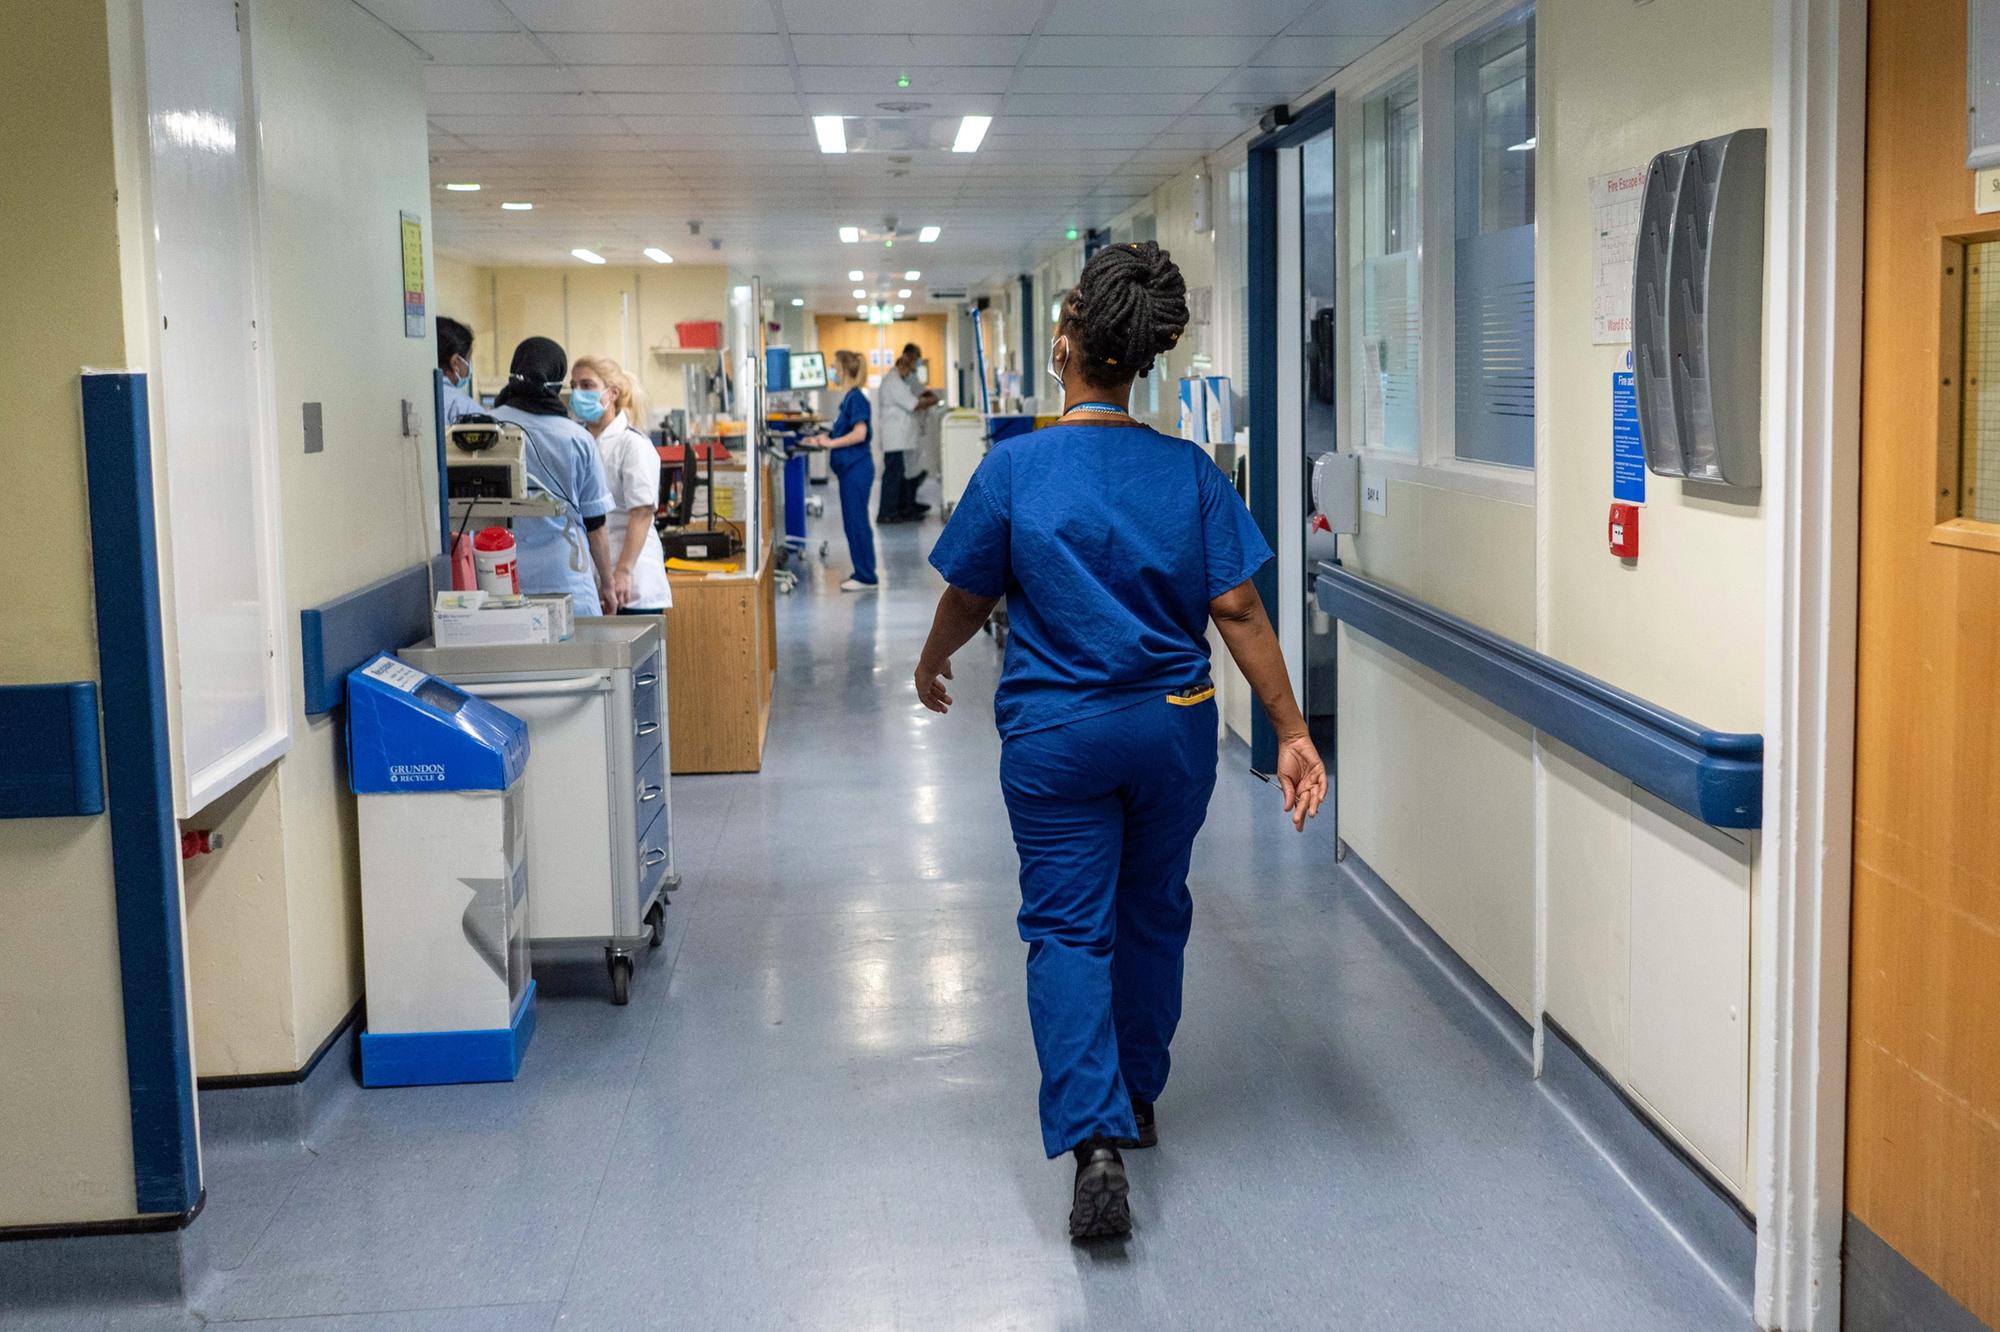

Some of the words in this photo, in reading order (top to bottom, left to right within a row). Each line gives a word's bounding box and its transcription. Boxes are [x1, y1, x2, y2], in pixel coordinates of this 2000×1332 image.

[1608, 179, 1618, 192] Fire
[1618, 375, 1627, 386] Fire
[390, 763, 445, 774] GRUNDON
[400, 773, 435, 782] RECYCLE
